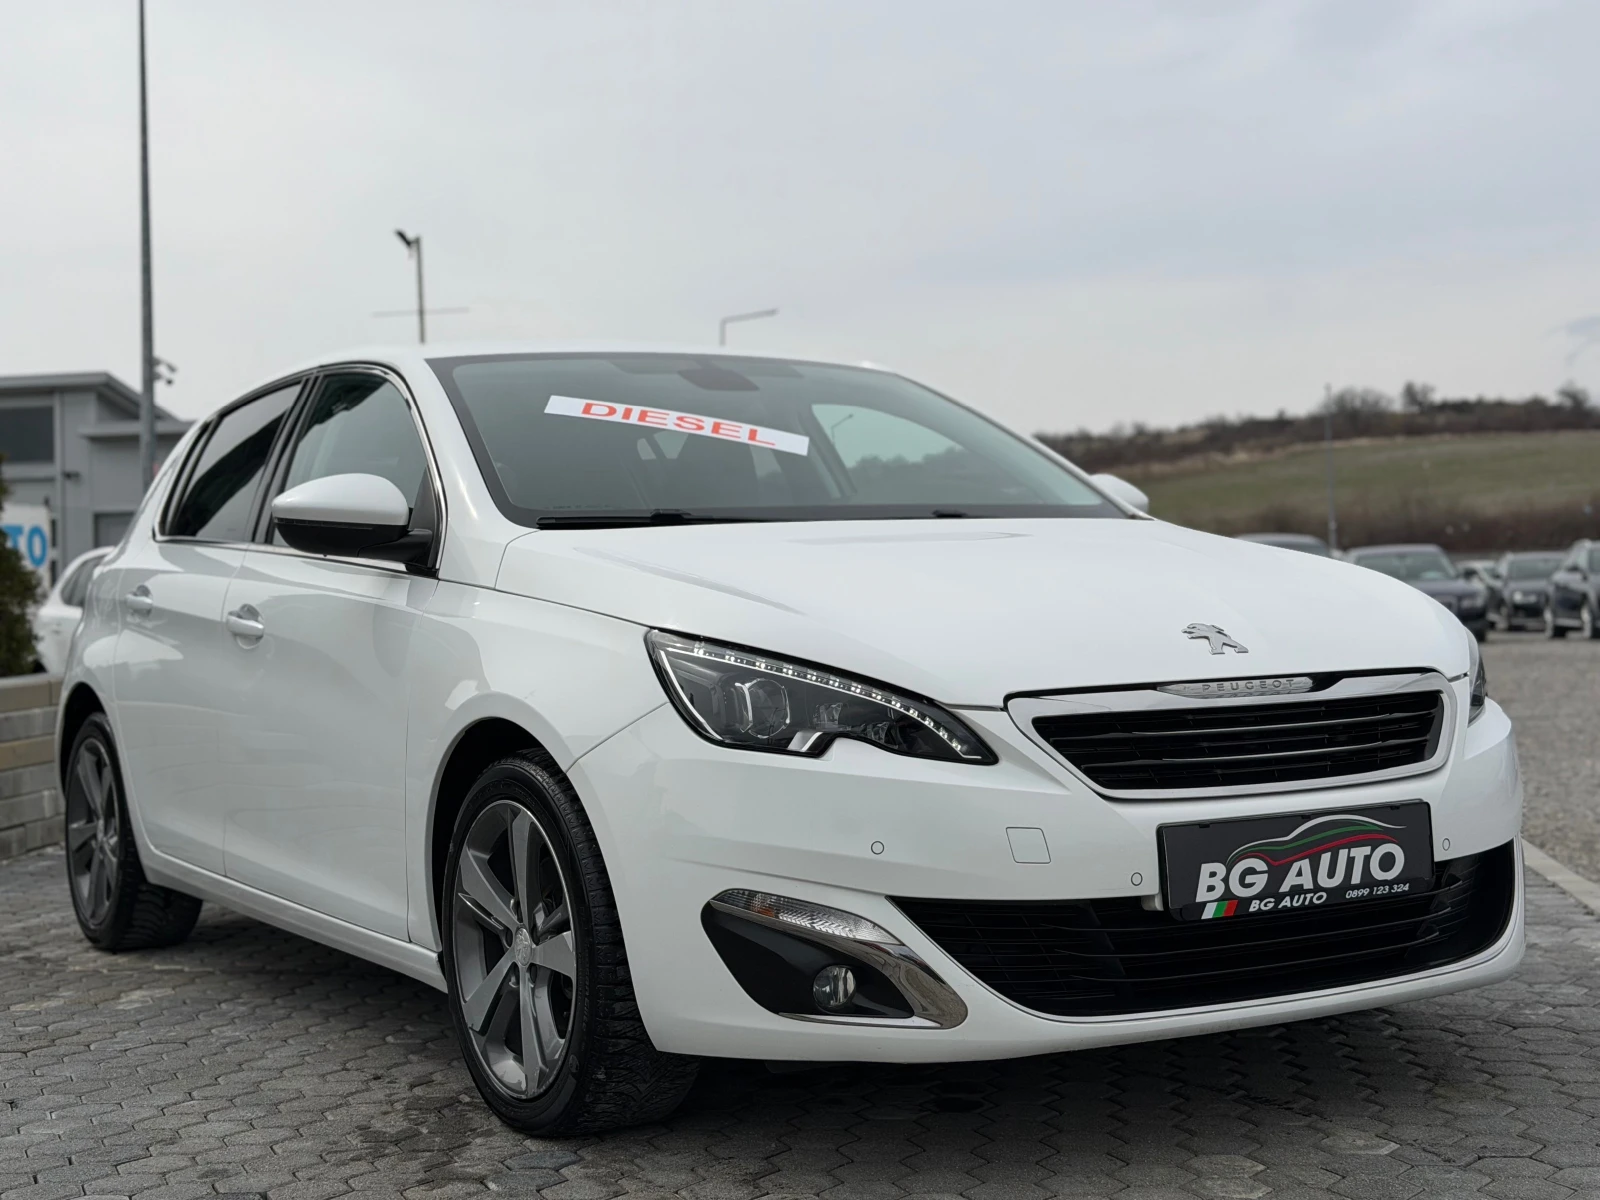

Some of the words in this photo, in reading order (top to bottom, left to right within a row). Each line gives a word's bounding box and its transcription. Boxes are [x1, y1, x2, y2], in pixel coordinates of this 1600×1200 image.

[581, 402, 776, 446] DIESEL
[1202, 678, 1295, 692] PEUGEOT
[1195, 857, 1269, 903] BG
[1278, 843, 1405, 893] AUTO
[1345, 887, 1370, 899] 0899
[1372, 885, 1390, 895] 123
[1391, 882, 1410, 893] 324
[1249, 897, 1276, 912] BG
[1277, 891, 1328, 909] AUTO
